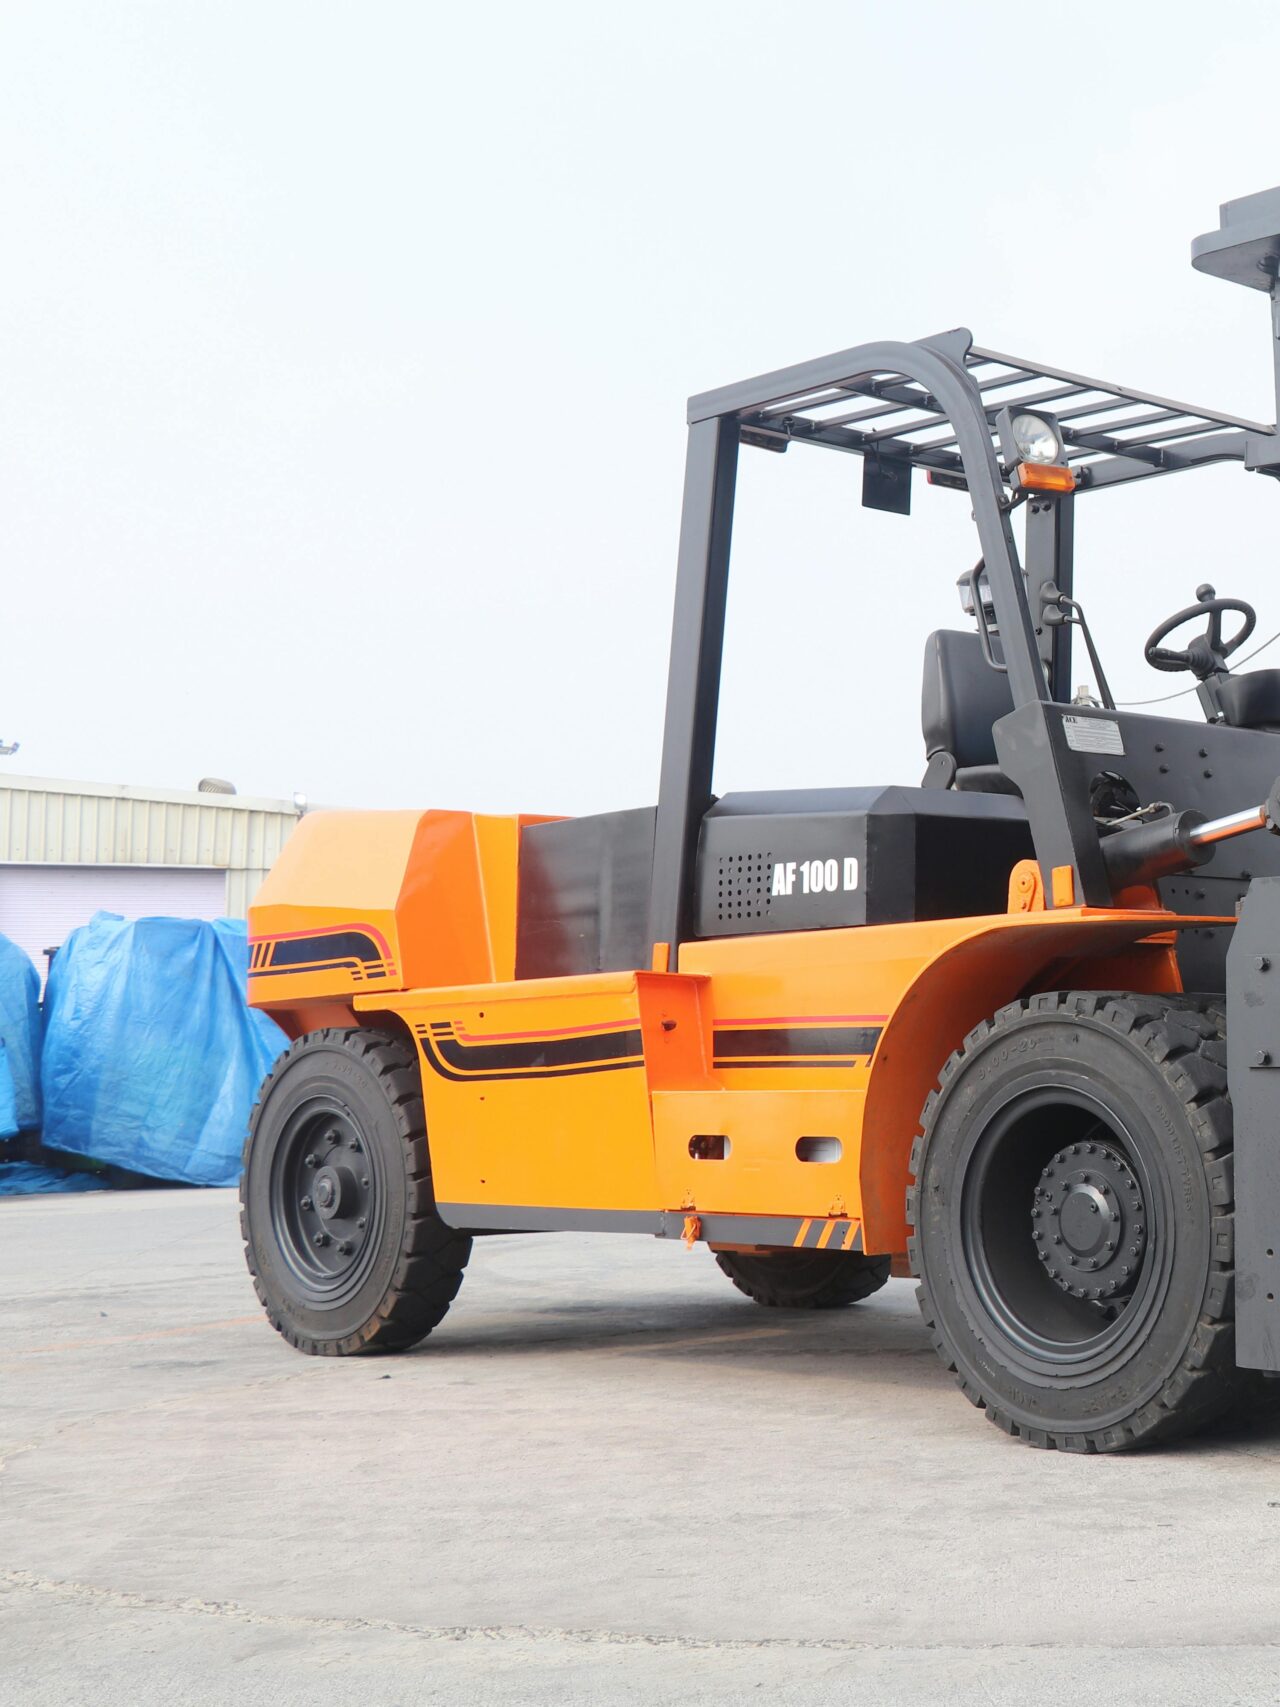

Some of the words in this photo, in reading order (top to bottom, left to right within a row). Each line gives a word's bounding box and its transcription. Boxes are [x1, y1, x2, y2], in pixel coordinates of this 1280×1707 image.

[771, 862, 797, 896] AF
[799, 858, 839, 894] 100
[843, 857, 858, 891] D
